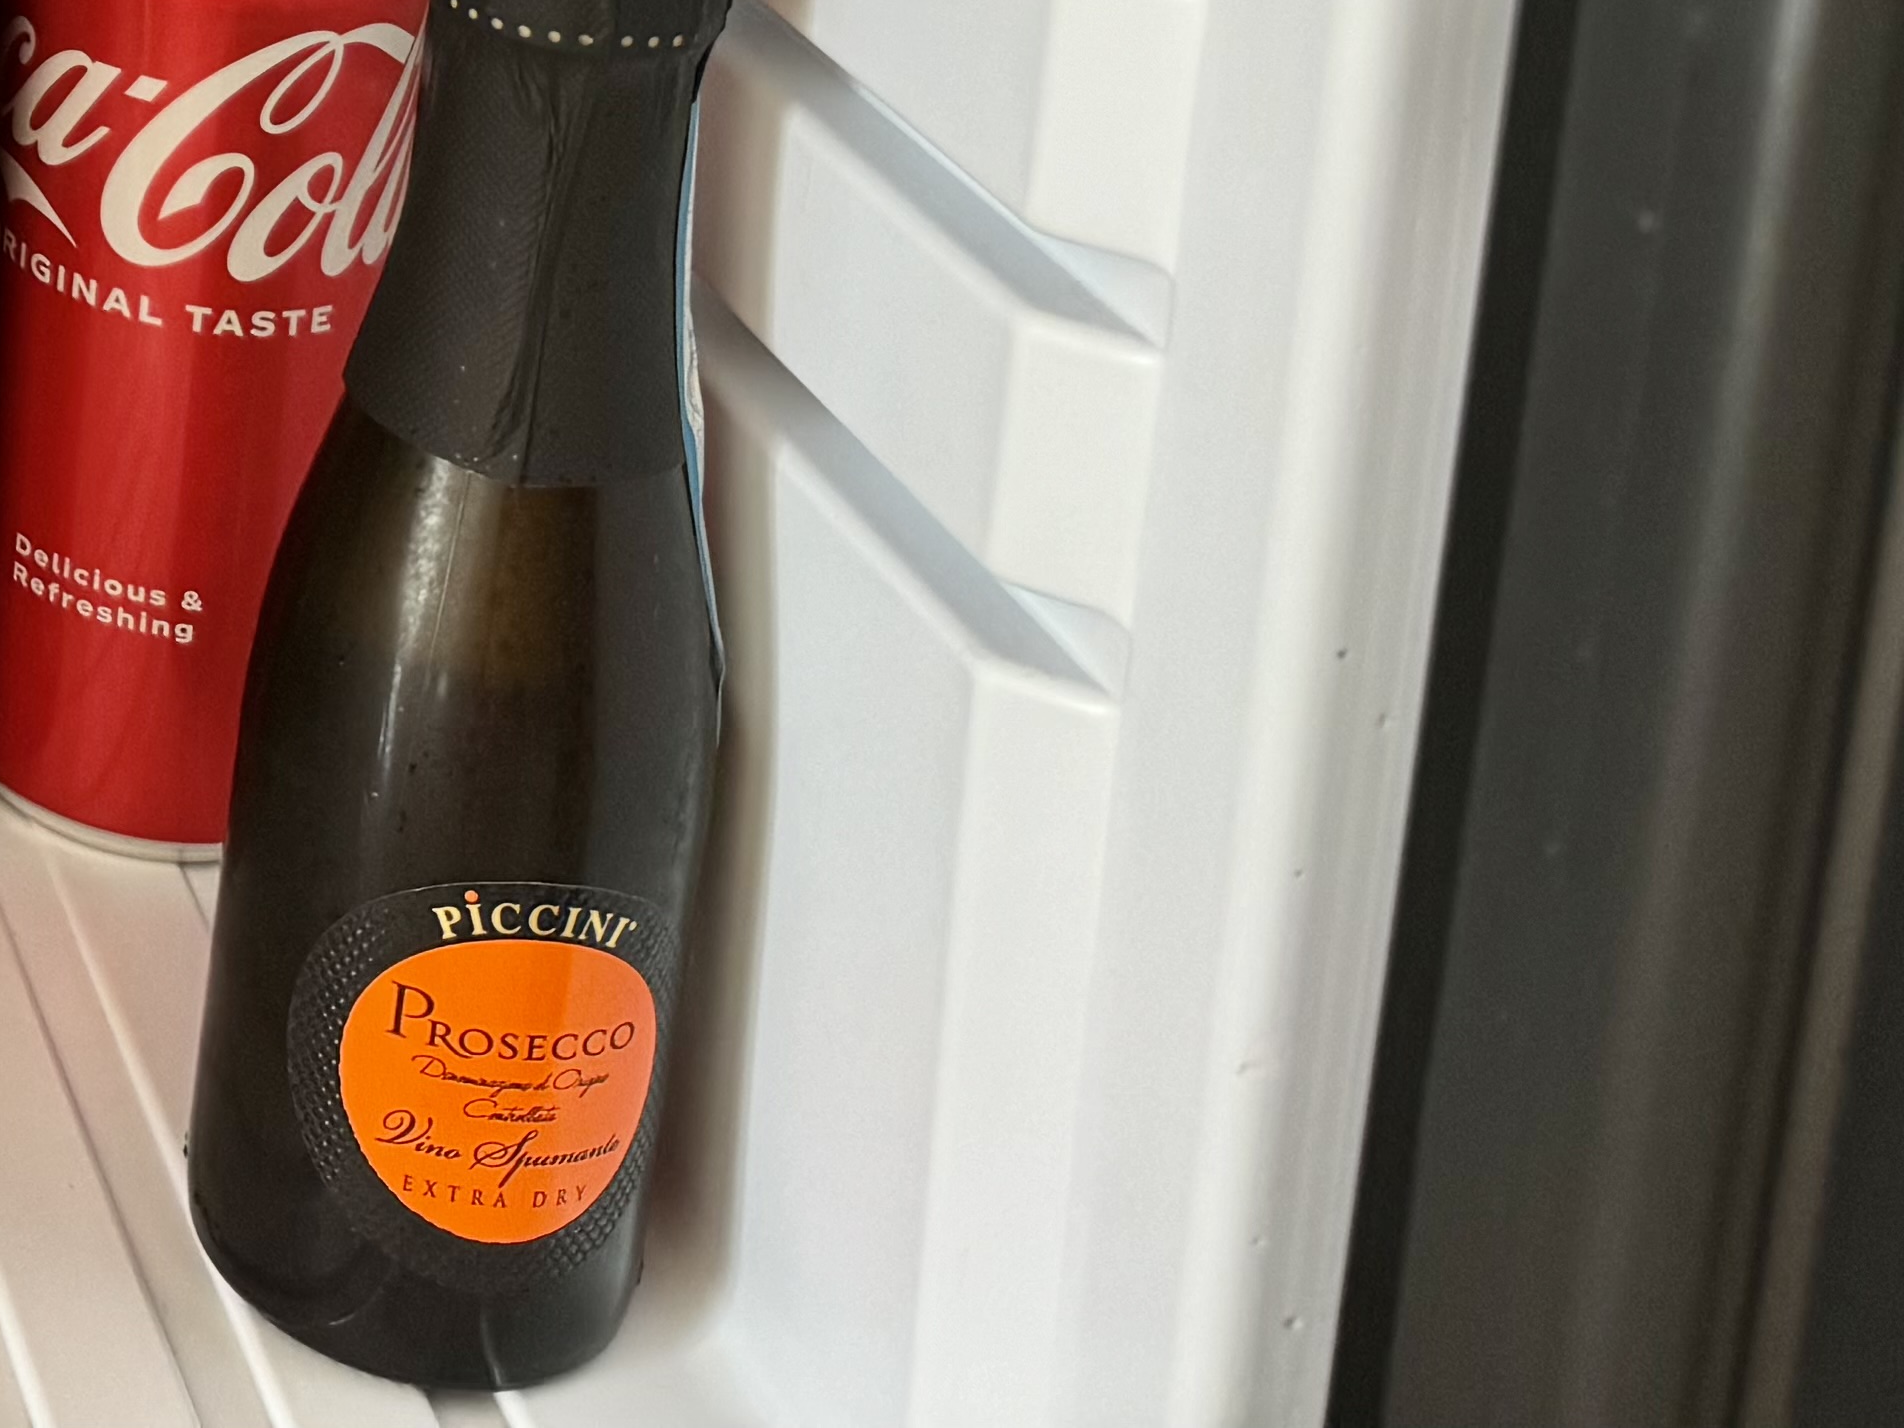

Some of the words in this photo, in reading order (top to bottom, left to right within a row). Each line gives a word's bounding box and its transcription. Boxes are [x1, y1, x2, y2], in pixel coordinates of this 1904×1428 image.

[185, 304, 334, 339] TASTE
[13, 530, 169, 608] Delicious
[178, 588, 205, 615] &
[11, 558, 196, 645] Refreshing
[374, 1108, 464, 1161] Vino
[402, 1174, 508, 1210] EXTRA
[531, 1184, 588, 1210] DRY
